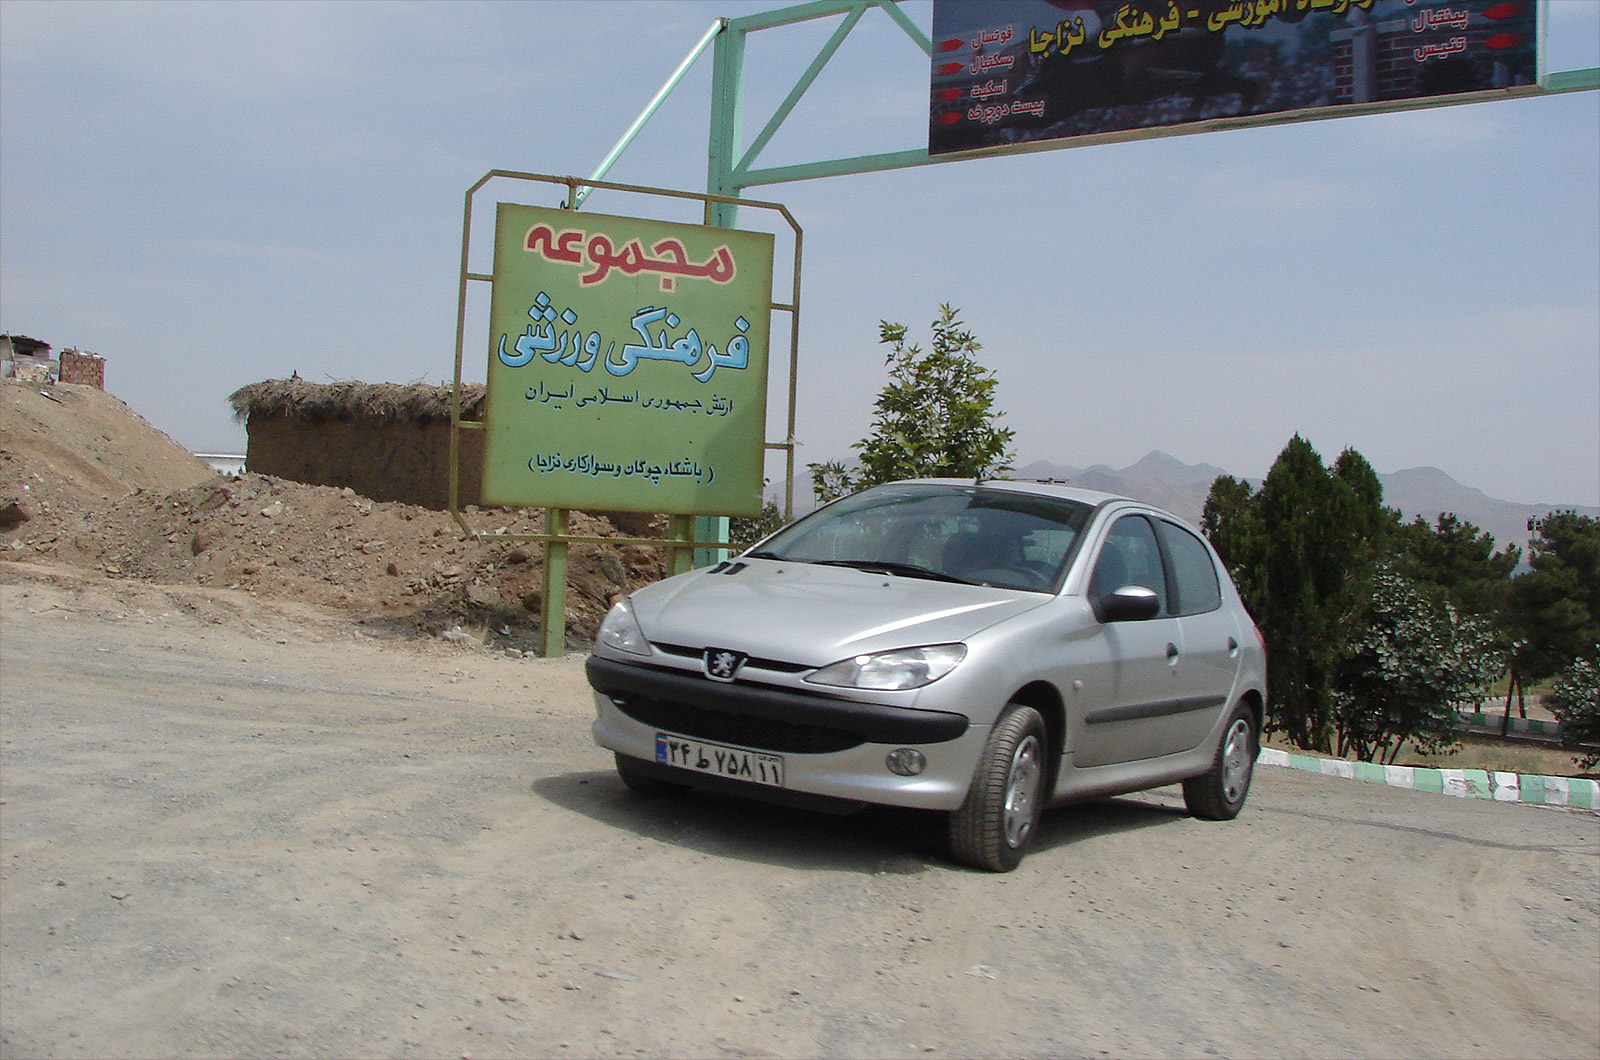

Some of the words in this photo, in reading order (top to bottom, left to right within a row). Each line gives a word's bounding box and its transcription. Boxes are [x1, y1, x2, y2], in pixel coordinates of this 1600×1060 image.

[1099, 0, 1180, 49] فرهنگی
[1412, 7, 1469, 33] پینتبال
[971, 24, 1013, 49] فوتسال
[1029, 16, 1086, 58] نزاجا
[1413, 36, 1467, 62] تنیس
[970, 52, 1015, 75] بسکتبال
[970, 79, 1007, 101] اسکیت
[967, 103, 1010, 125] دوچرخه
[1010, 100, 1045, 117] پیست
[523, 222, 737, 293] مجموعه
[498, 291, 602, 373] ورزشی
[604, 306, 750, 383] فرهنگی
[525, 381, 575, 410] ایران
[576, 387, 639, 408] اسلامی
[642, 397, 703, 413] جمهوری
[706, 394, 733, 416] ارتش
